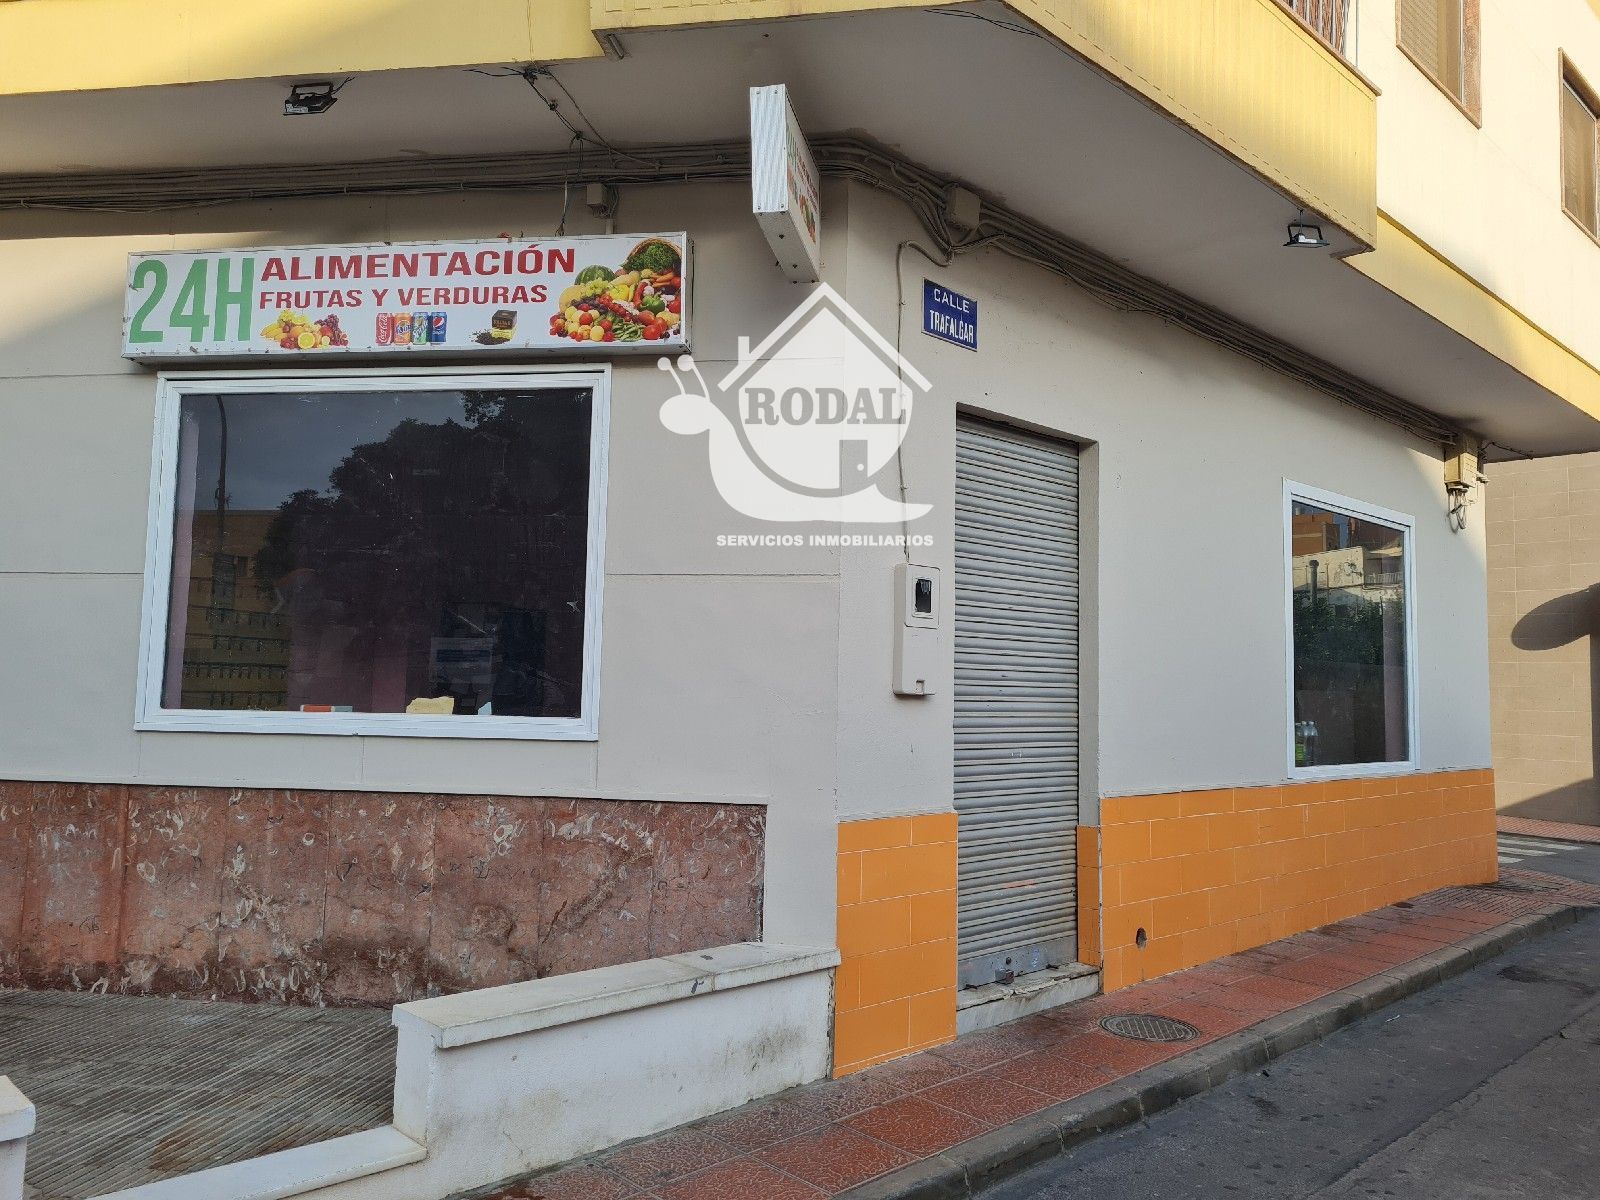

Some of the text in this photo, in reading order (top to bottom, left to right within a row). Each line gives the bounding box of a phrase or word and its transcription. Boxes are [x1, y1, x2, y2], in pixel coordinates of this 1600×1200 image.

[261, 246, 575, 281] ALIMENTACIÓN
[129, 257, 255, 343] 24H
[259, 284, 548, 309] FRUTAS Y VERDURAS
[933, 288, 970, 313] CALLE
[929, 310, 974, 344] TRAFALGAR
